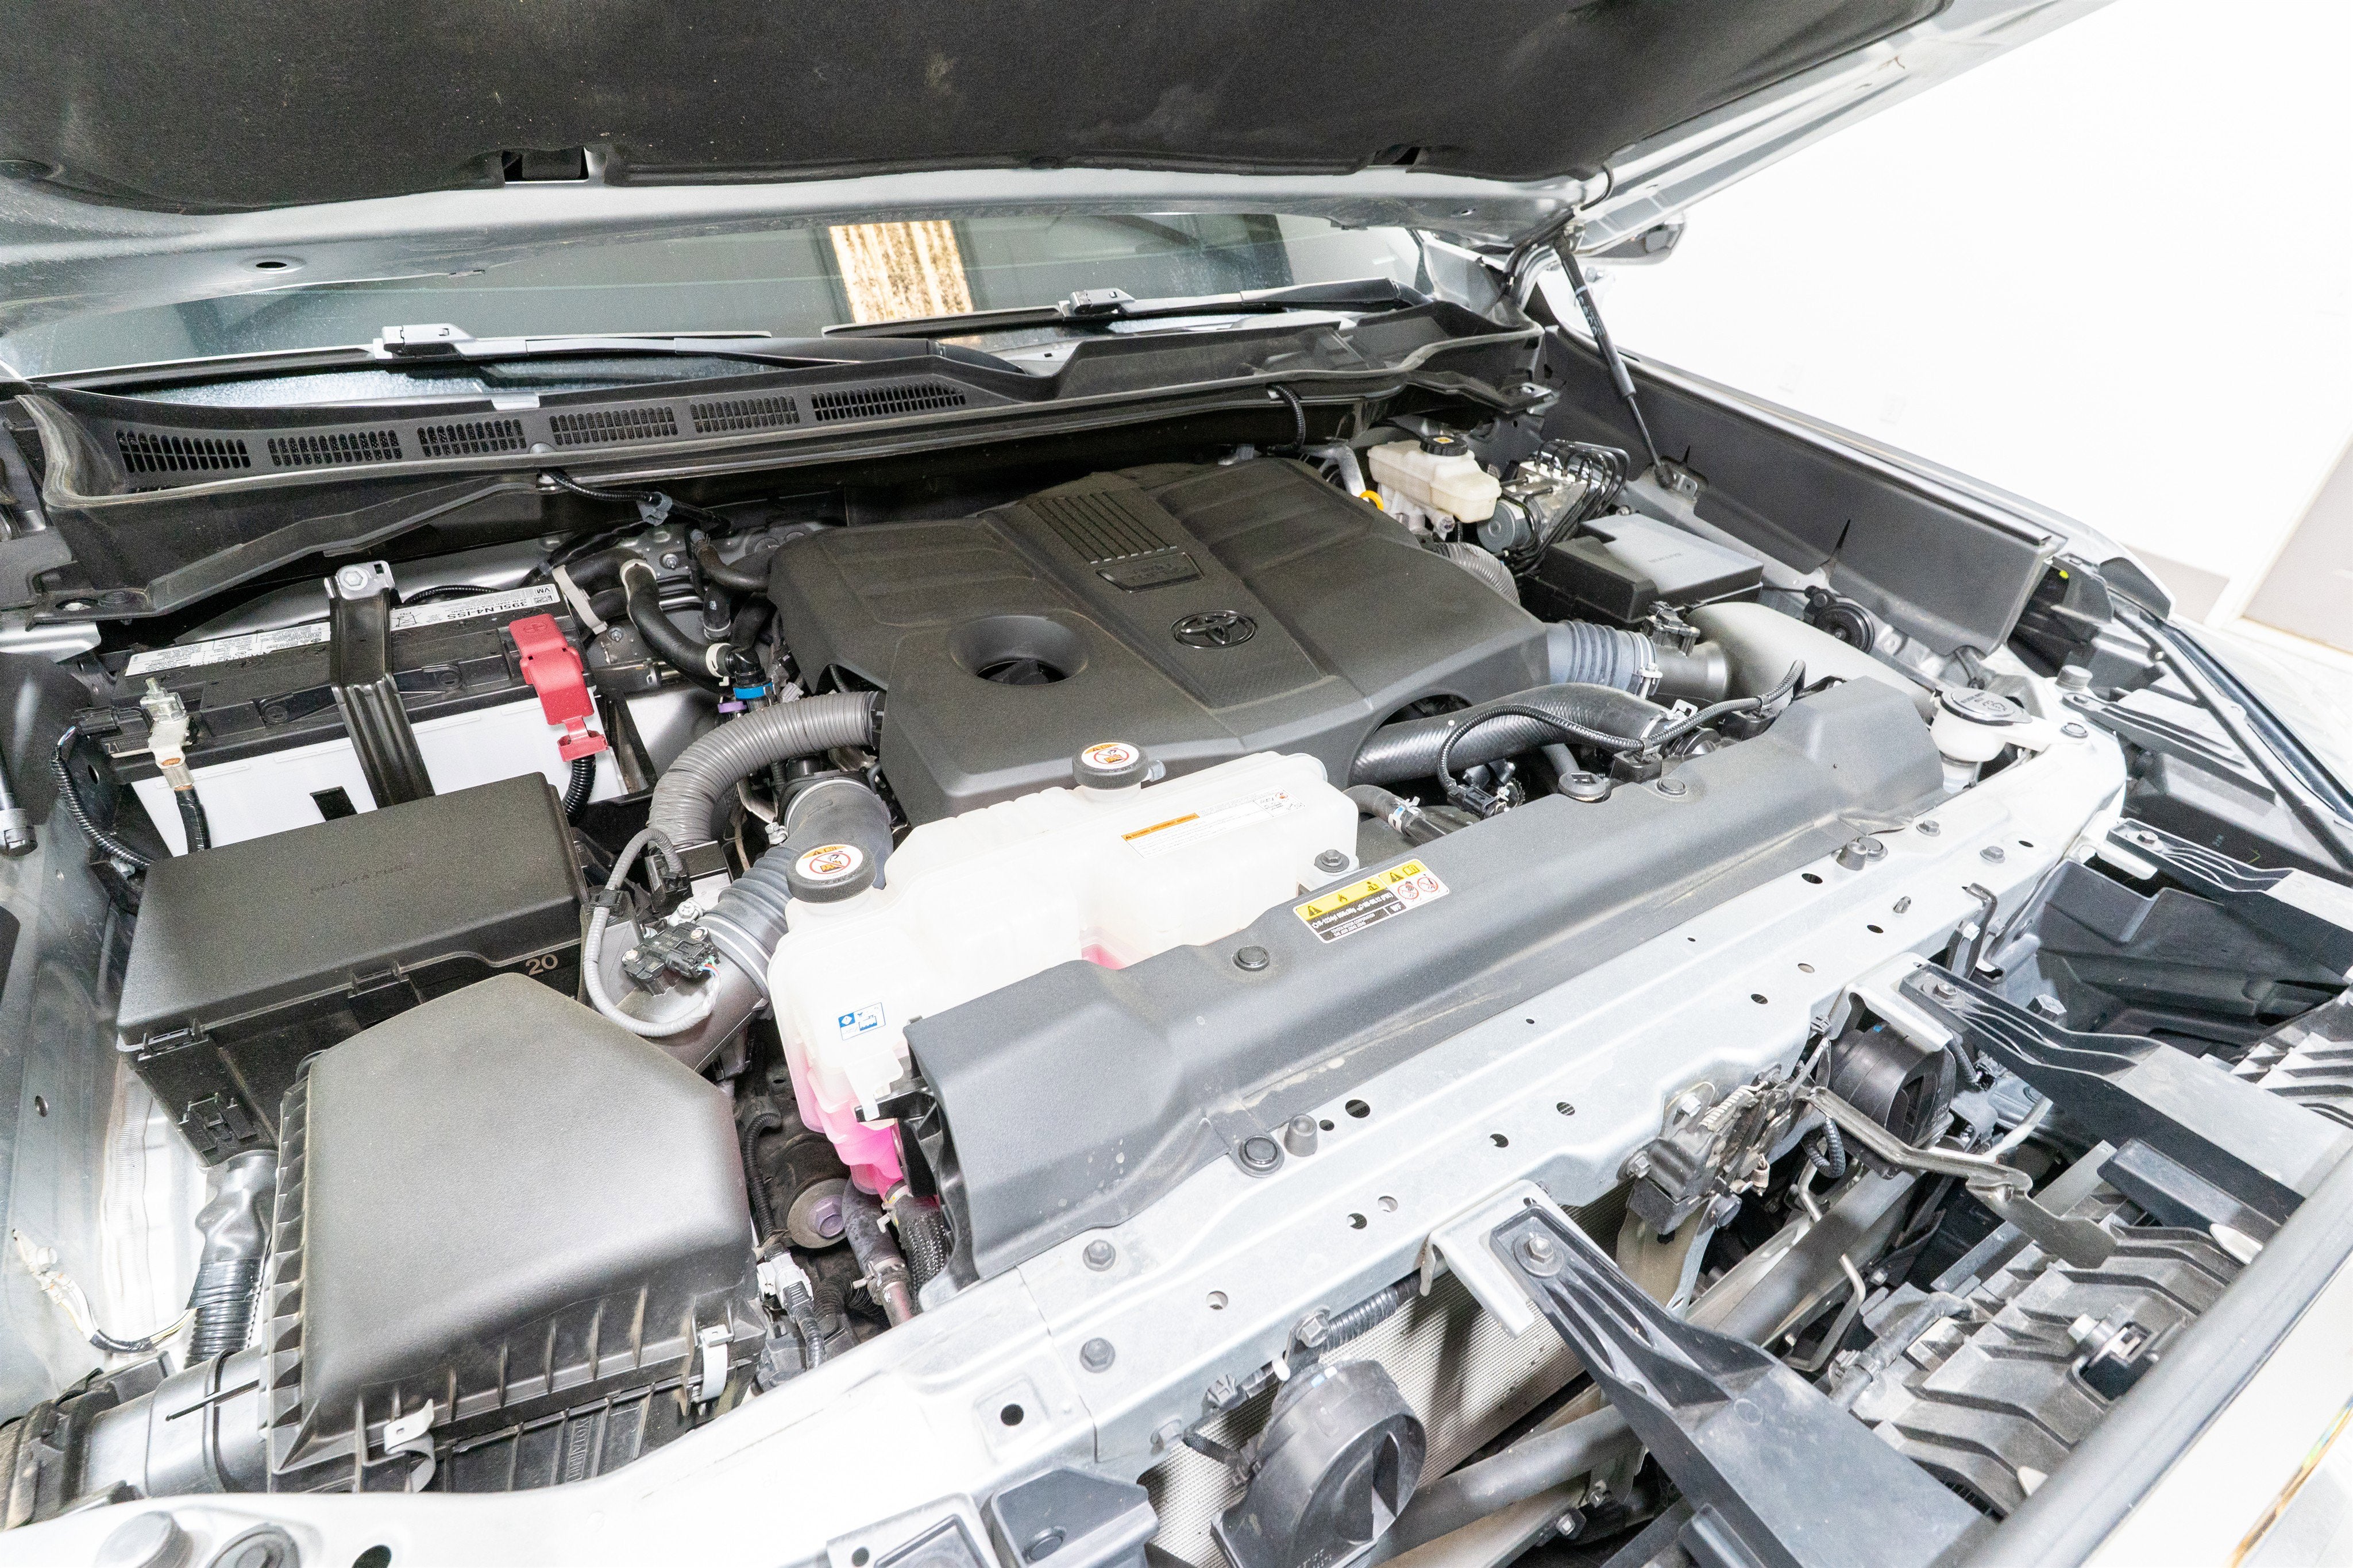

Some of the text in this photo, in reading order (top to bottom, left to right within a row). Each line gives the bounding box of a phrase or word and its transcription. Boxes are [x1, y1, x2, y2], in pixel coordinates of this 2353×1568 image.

[447, 601, 528, 619] 395LN4-ISS
[1390, 903, 1402, 912] WF
[525, 953, 558, 976] 20
